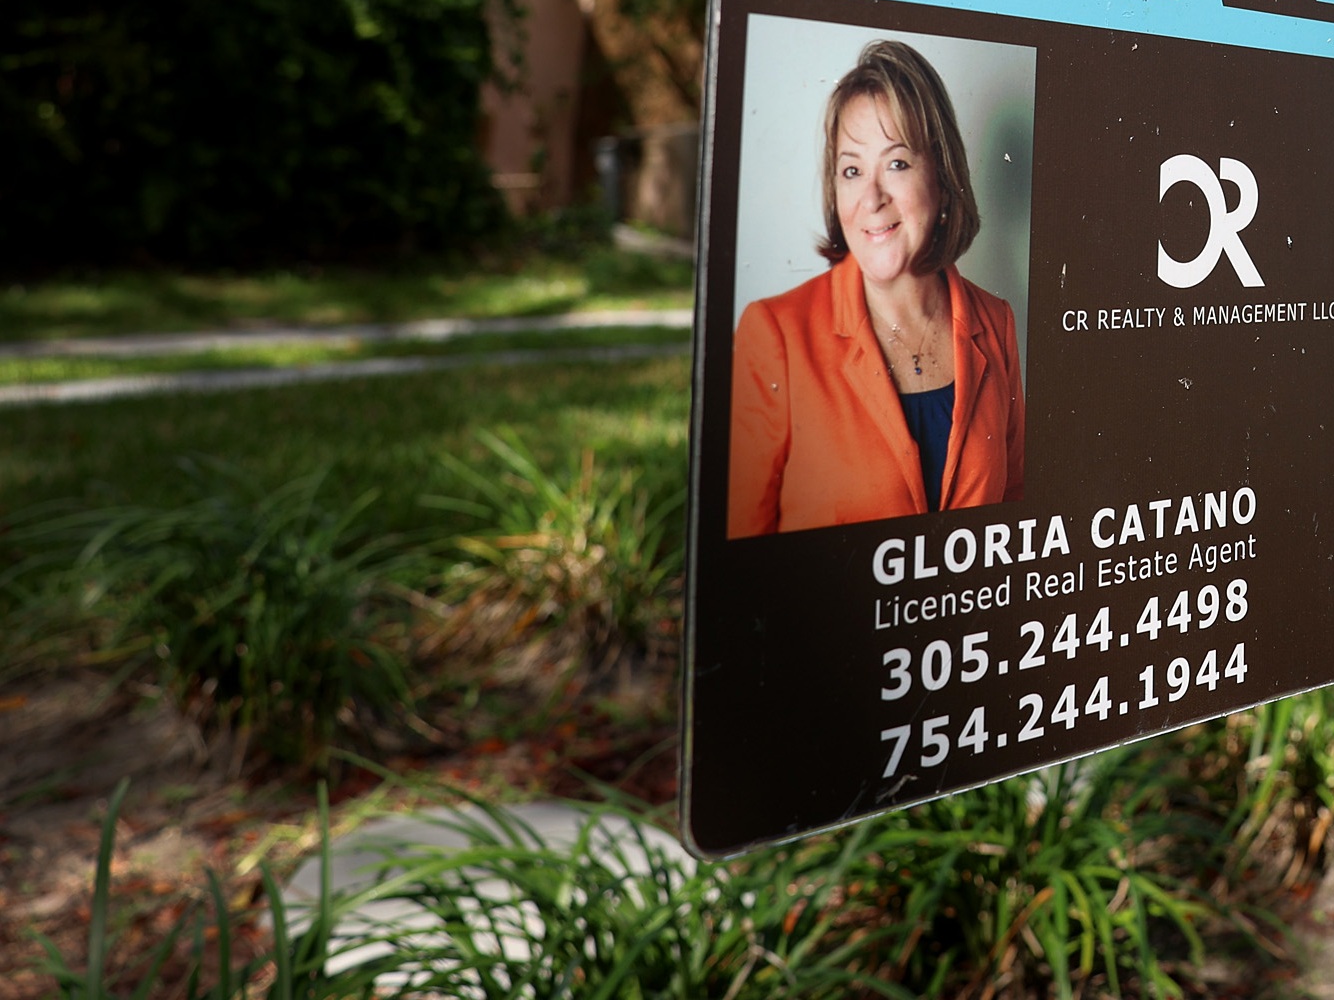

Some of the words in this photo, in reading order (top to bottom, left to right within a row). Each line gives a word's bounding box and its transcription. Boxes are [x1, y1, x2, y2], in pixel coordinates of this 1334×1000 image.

[1062, 310, 1089, 332] CR
[1097, 307, 1167, 330] REALTY
[1173, 307, 1186, 327] &
[1193, 302, 1308, 326] MANAGEMENT
[872, 515, 1070, 586] GLORIA
[1090, 486, 1258, 549] CATANO
[874, 580, 1011, 630] Licensed
[1026, 563, 1084, 601] Real
[1098, 550, 1178, 588] Estate
[1188, 533, 1257, 574] Agent
[880, 578, 1249, 701] 305.244.4498
[880, 642, 1249, 780] 754.244.1944
